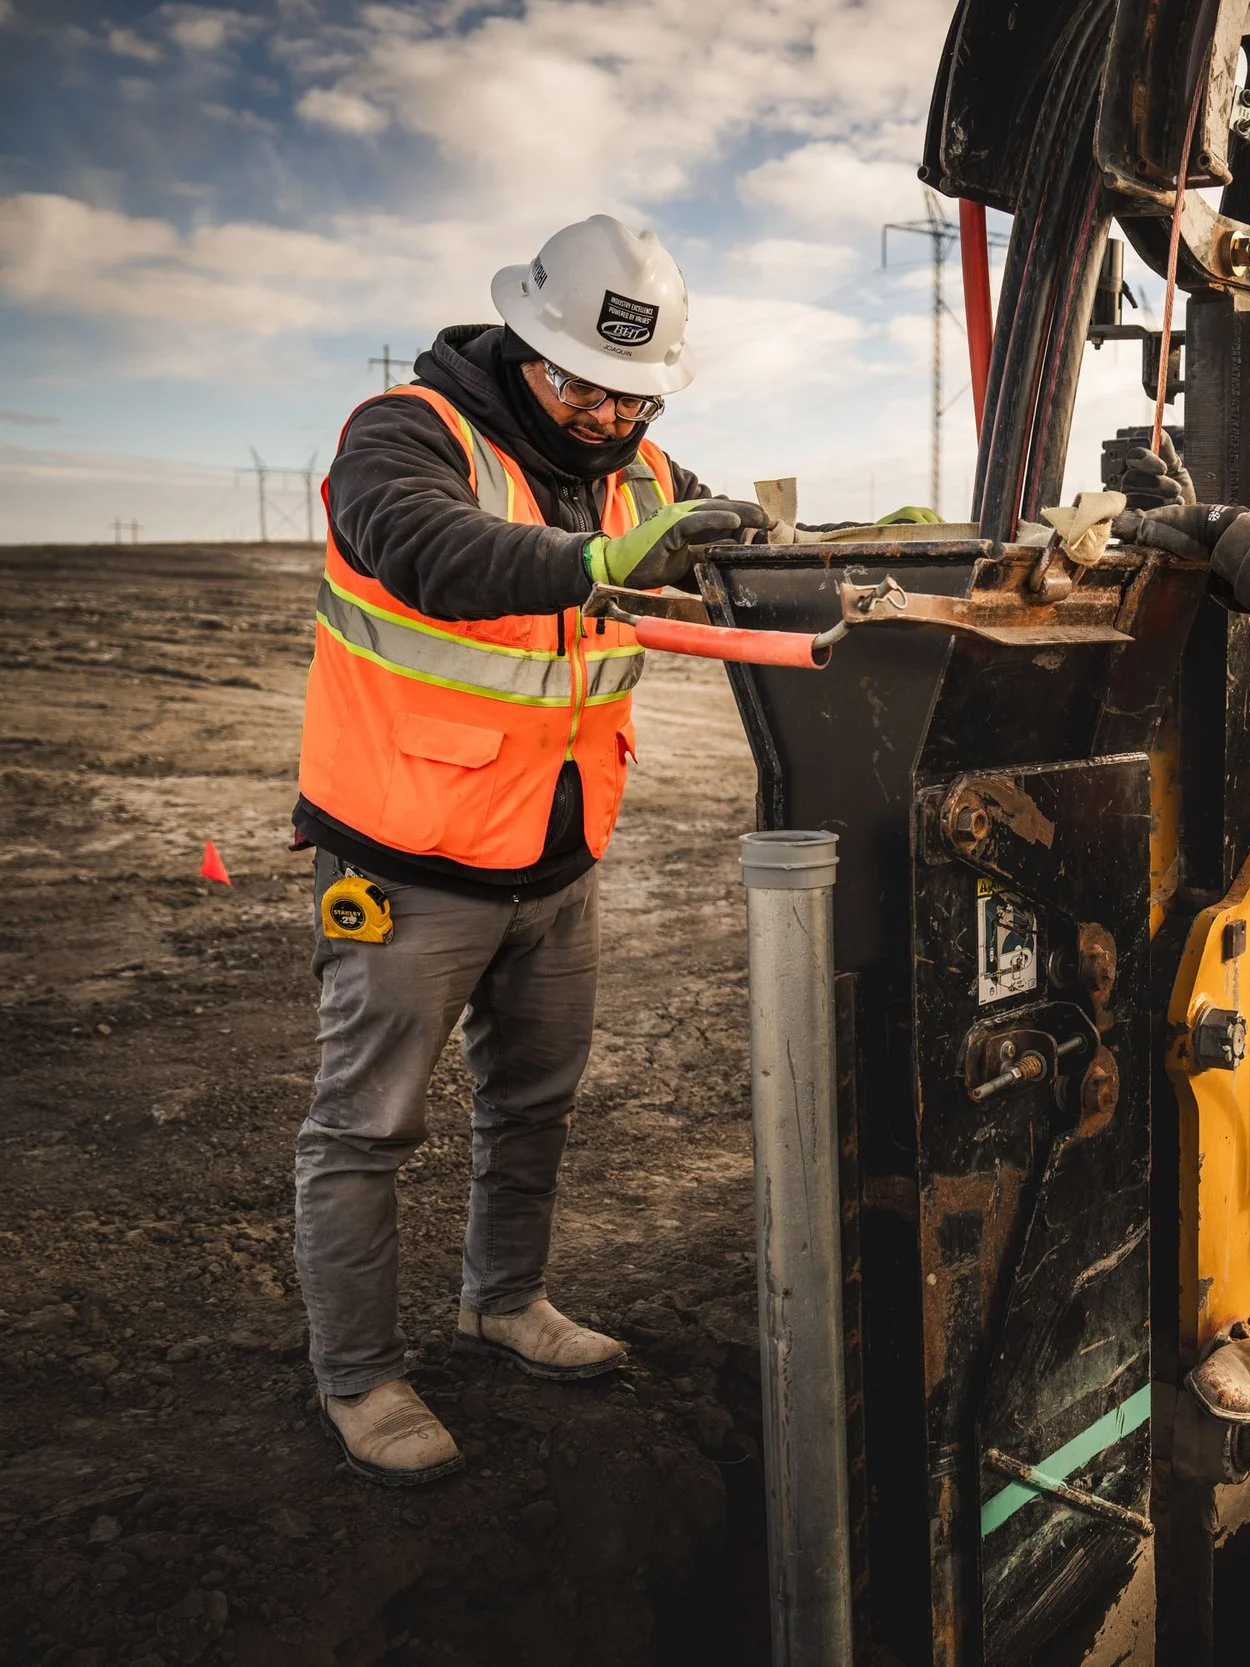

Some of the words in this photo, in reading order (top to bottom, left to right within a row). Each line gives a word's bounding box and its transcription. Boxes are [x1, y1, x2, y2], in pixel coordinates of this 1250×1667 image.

[610, 296, 631, 309] INDUSTRY
[631, 303, 654, 315] EXCELLENCE
[609, 306, 629, 319] POWERED
[629, 313, 635, 321] BY
[614, 324, 639, 340] BHI
[602, 344, 633, 357] JOAQUIN
[333, 909, 361, 917] STANLEY
